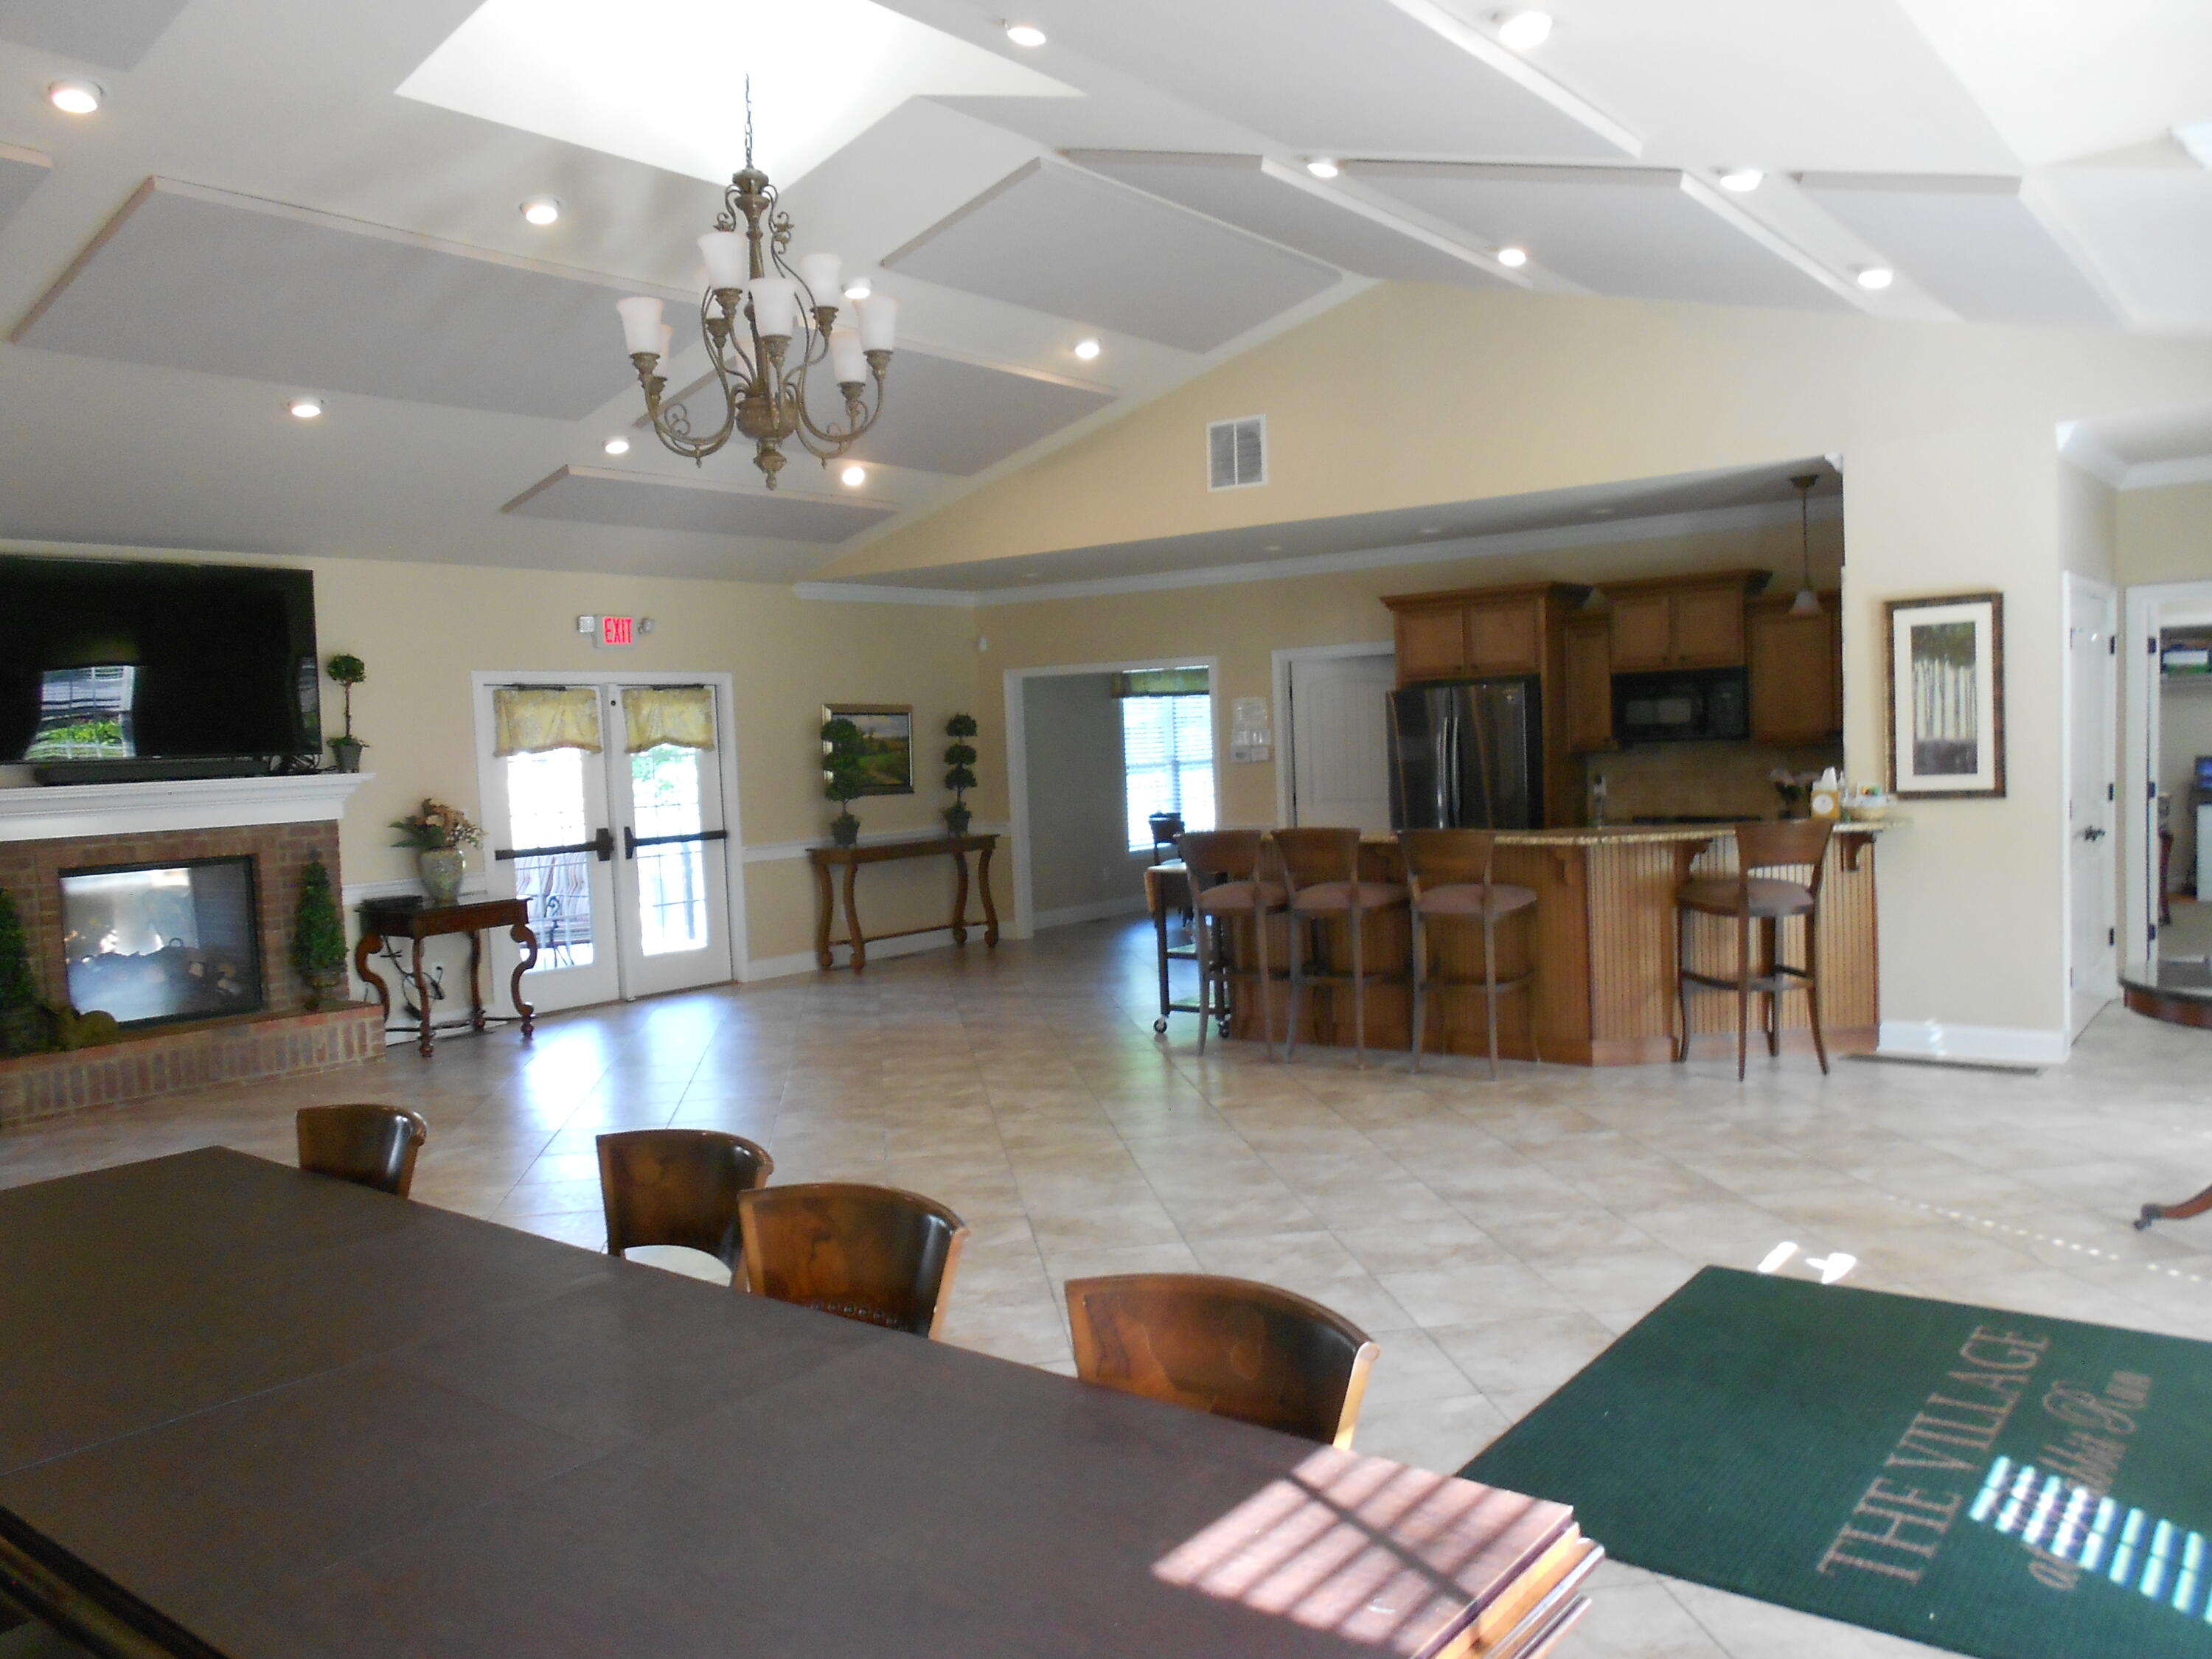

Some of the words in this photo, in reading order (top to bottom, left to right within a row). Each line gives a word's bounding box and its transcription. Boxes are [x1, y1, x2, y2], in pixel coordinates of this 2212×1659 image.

[602, 616, 633, 644] EXIT
[1885, 1326, 2052, 1472] VILLAGE
[1816, 1477, 1962, 1585] THE
